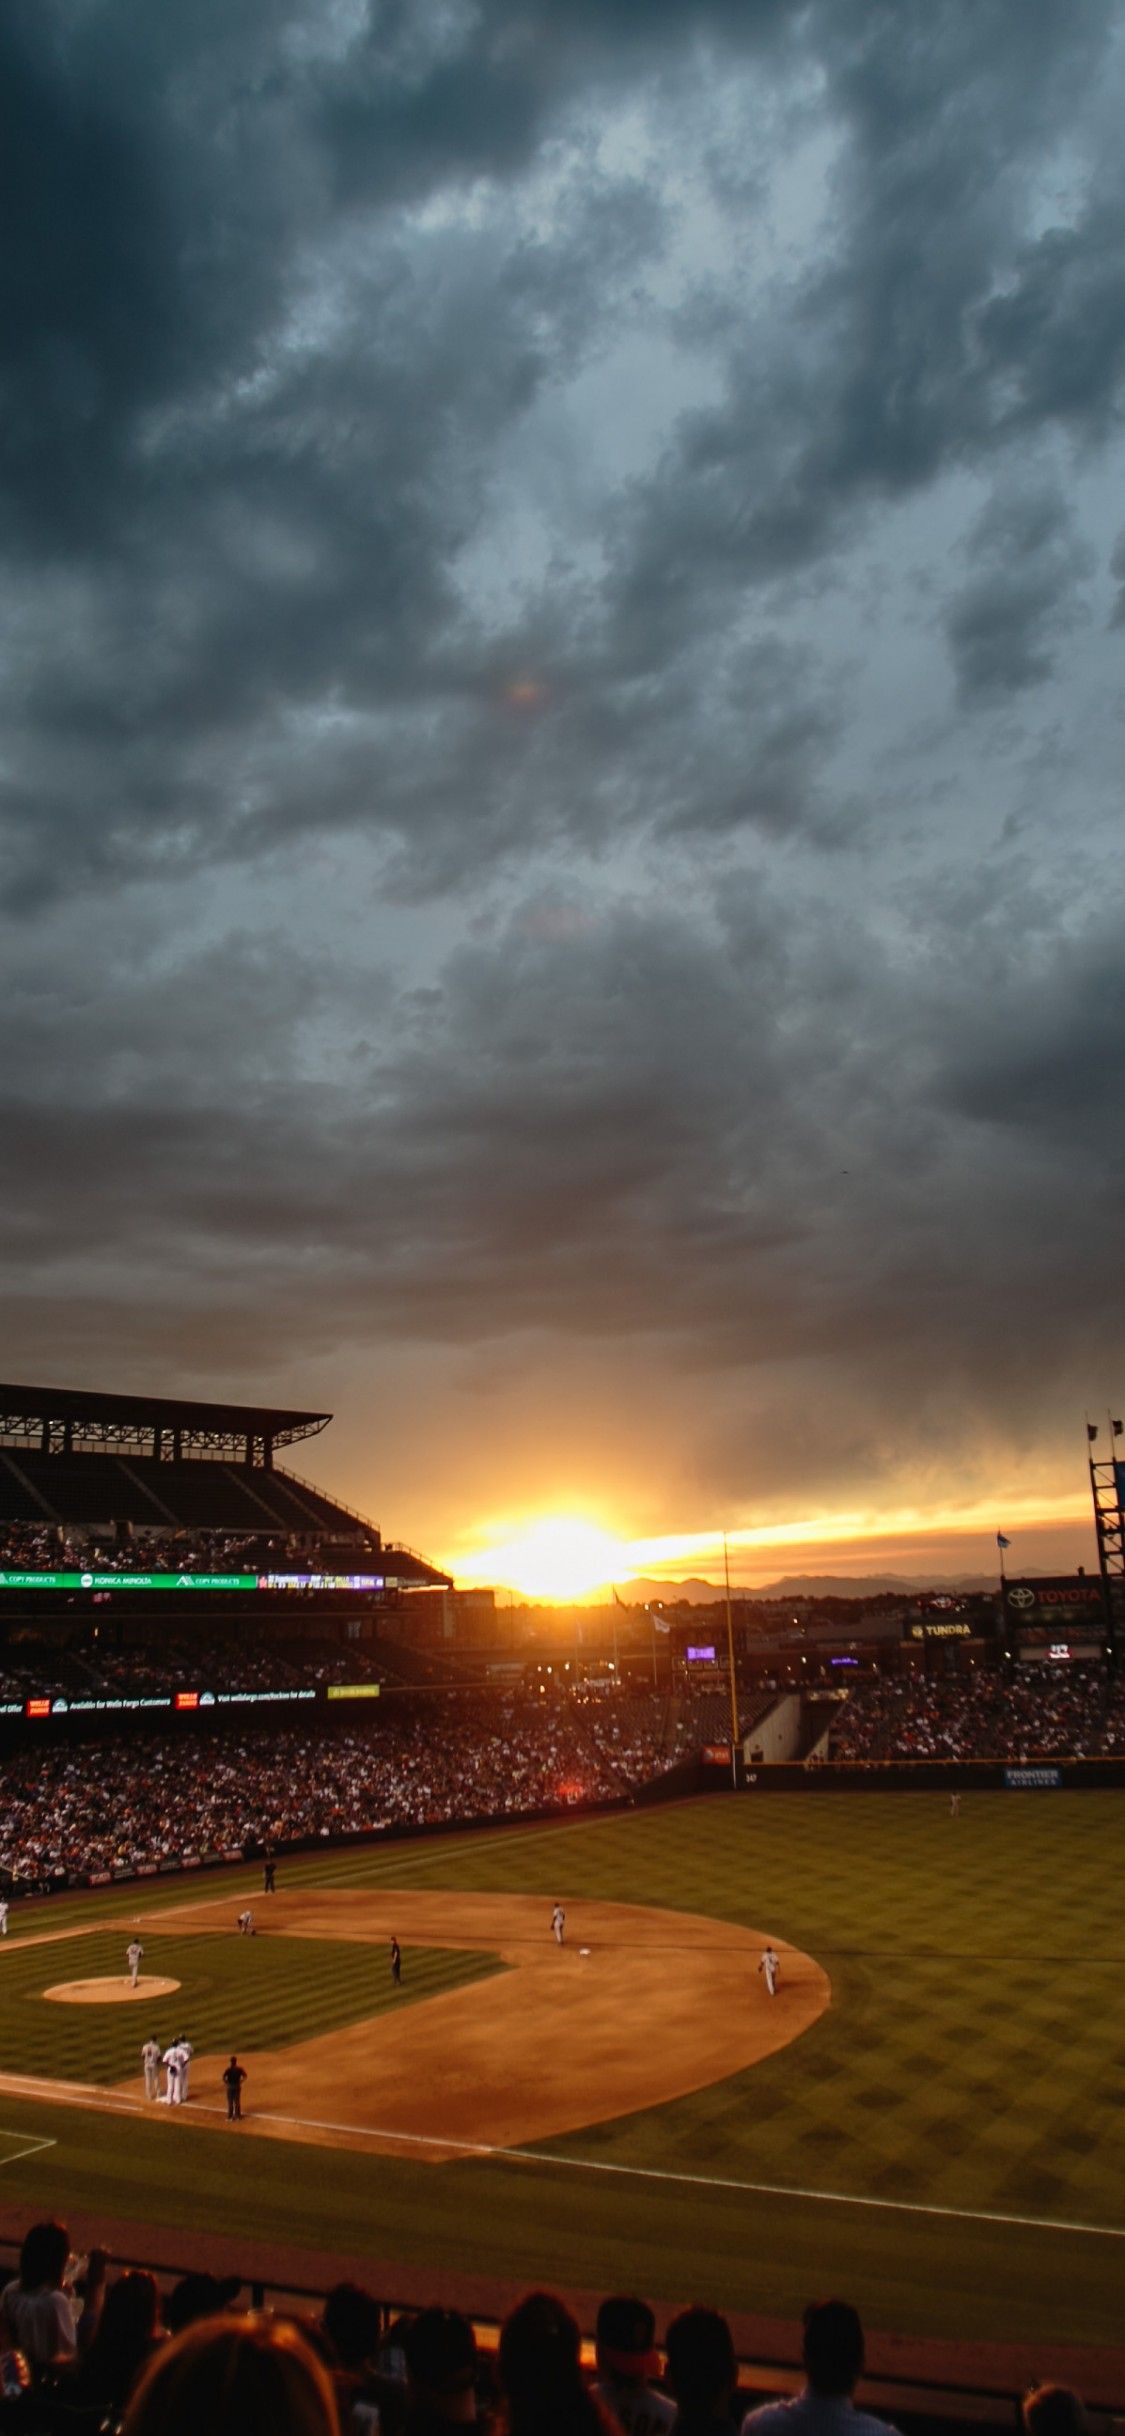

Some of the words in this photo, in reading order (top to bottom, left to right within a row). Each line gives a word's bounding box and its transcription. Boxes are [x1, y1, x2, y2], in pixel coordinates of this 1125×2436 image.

[94, 1577, 121, 1585] KONICA
[122, 1577, 152, 1585] MINOLTA
[1038, 1589, 1100, 1603] TOYOTA
[926, 1624, 971, 1635] TUNDRA
[1007, 1770, 1058, 1778] FRONTIER
[1010, 1778, 1056, 1786] AIRLINES
